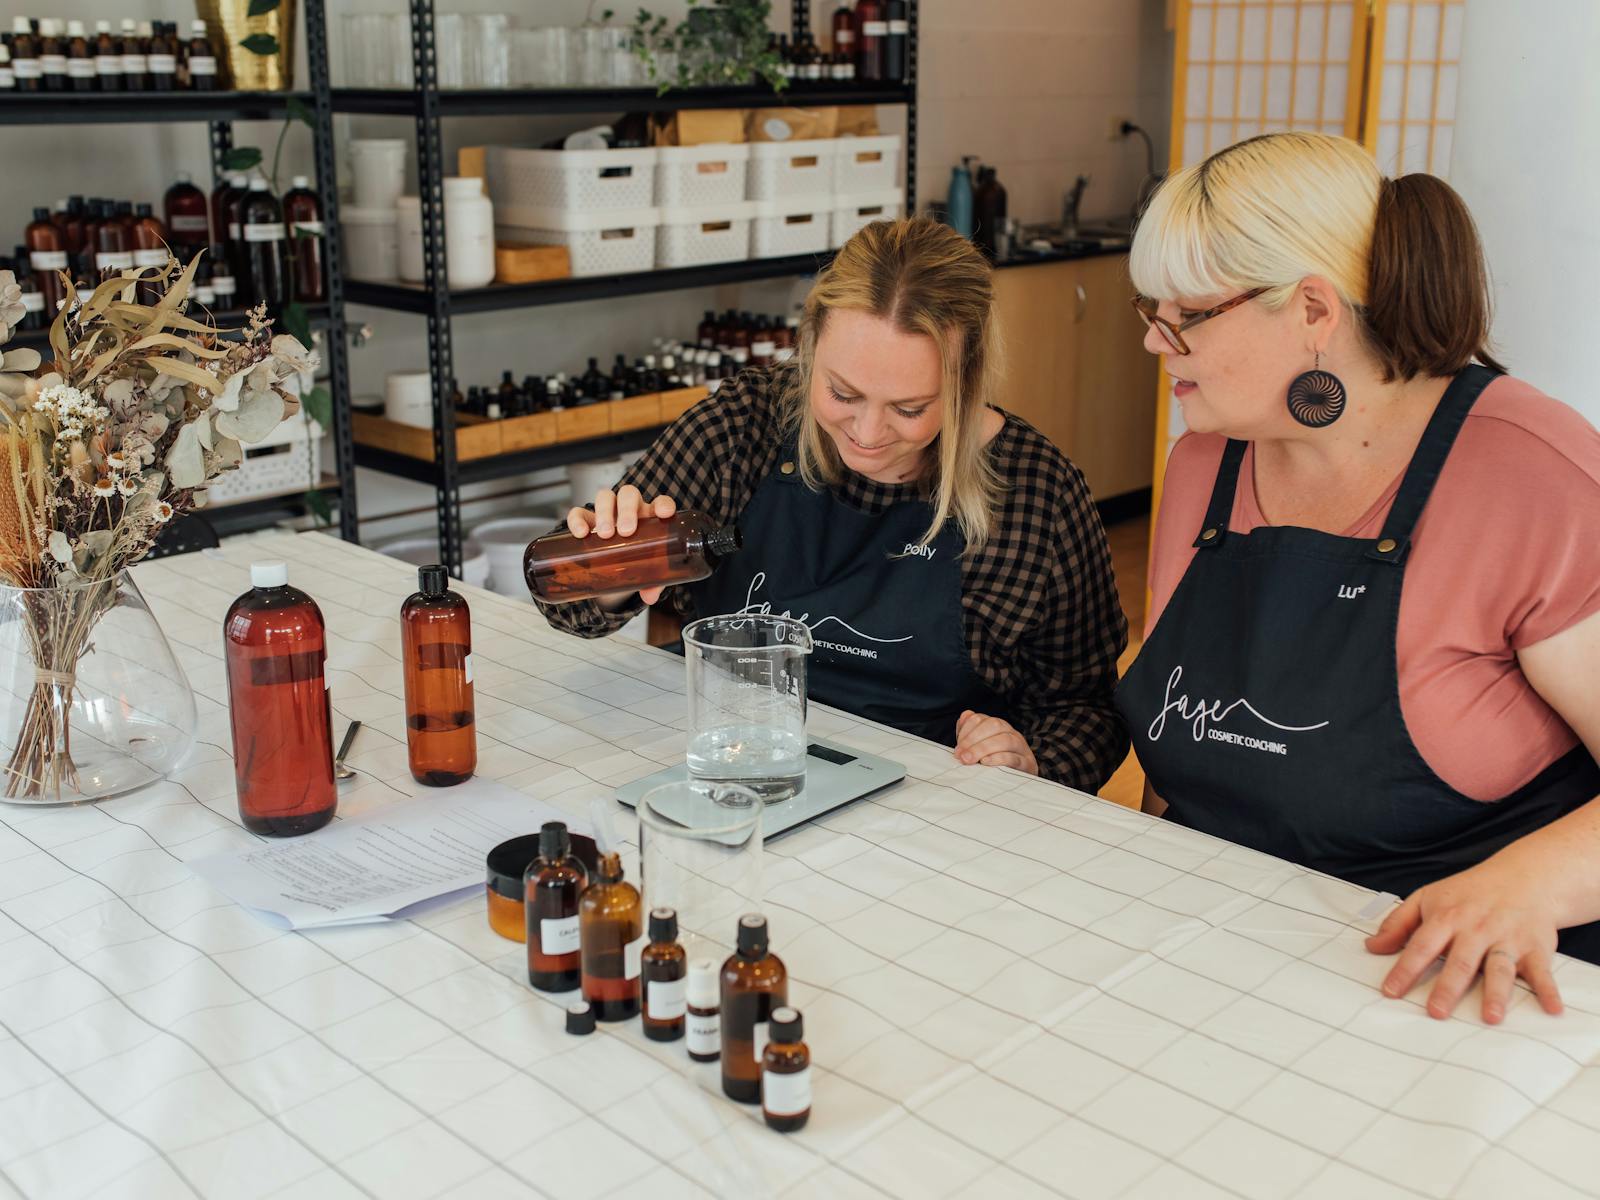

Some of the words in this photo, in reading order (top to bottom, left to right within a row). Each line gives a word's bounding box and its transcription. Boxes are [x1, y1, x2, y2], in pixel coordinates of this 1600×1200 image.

[903, 543, 937, 560] Polly
[835, 643, 878, 659] COACHING
[1207, 728, 1245, 746] COSMETIC
[1244, 736, 1287, 755] COACHING
